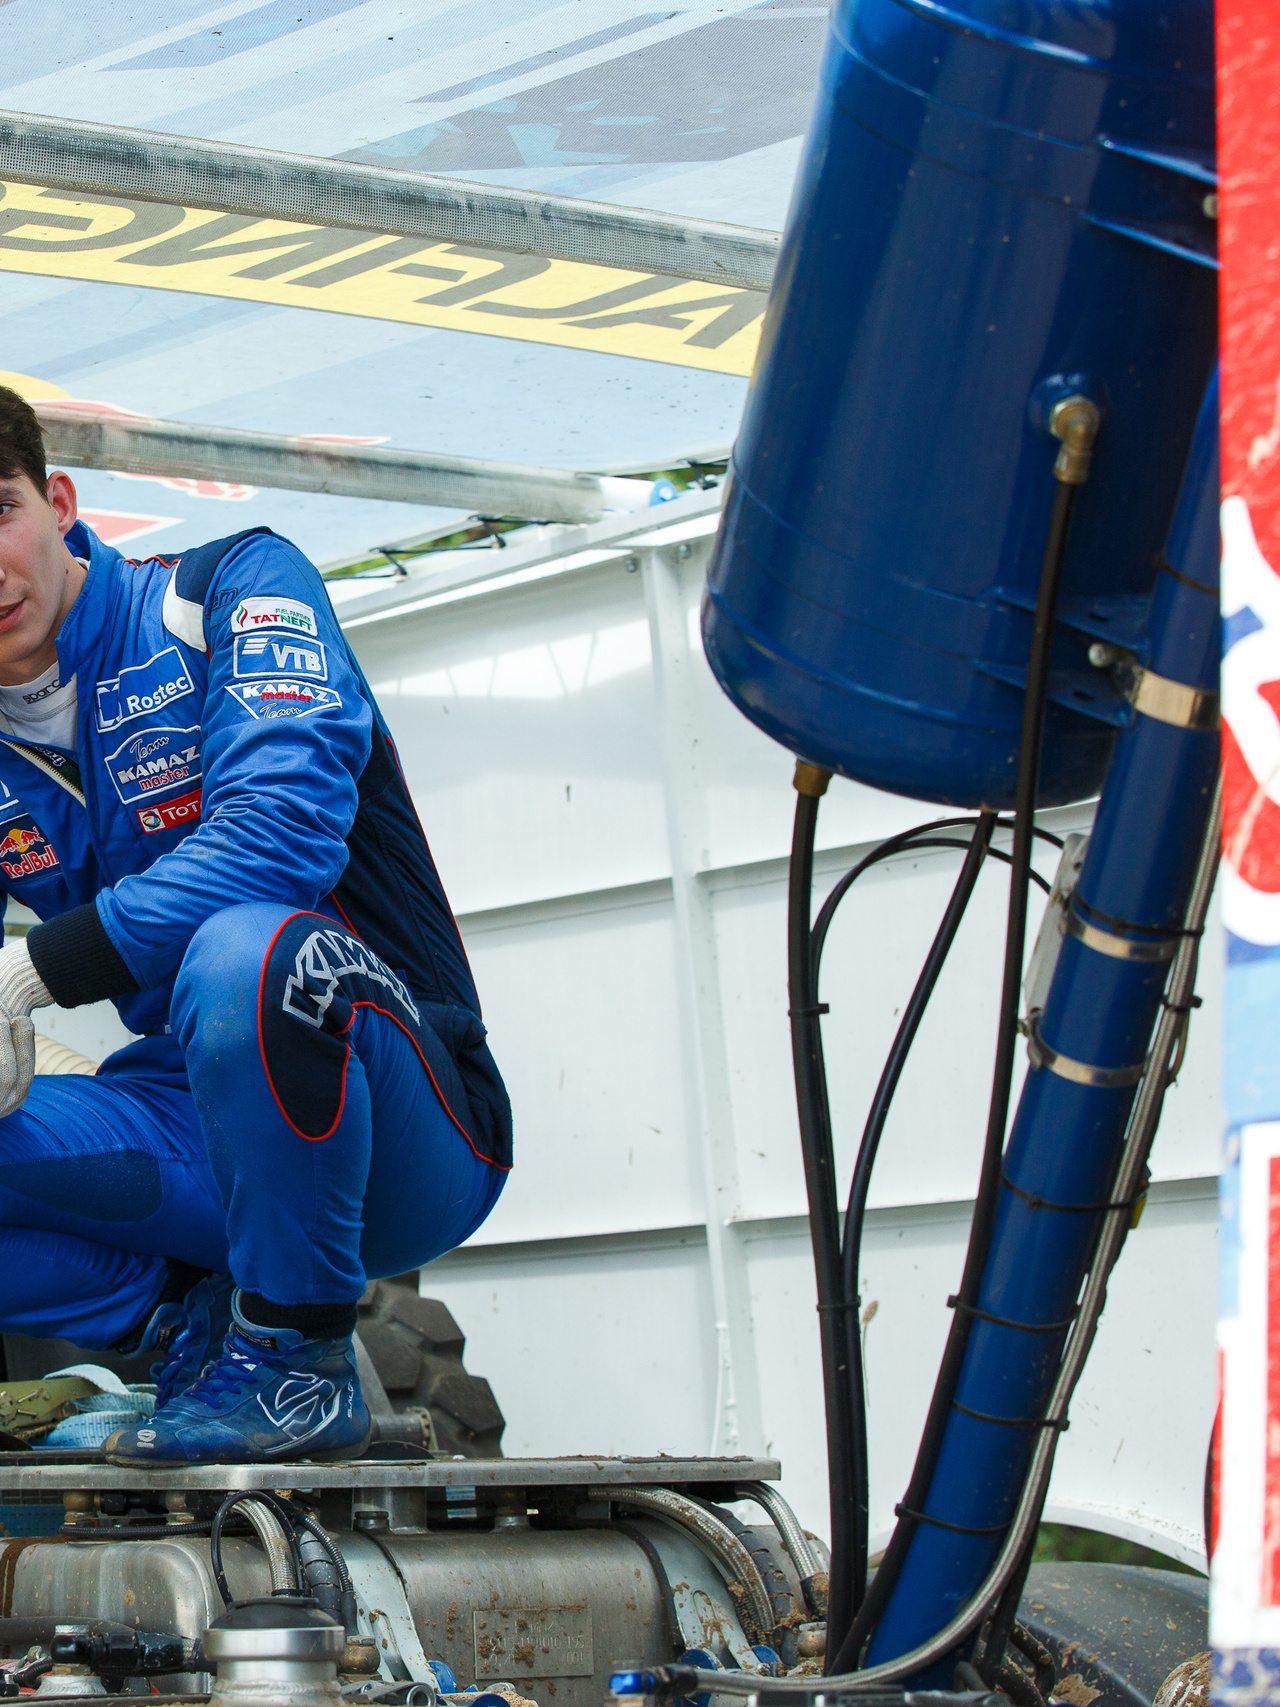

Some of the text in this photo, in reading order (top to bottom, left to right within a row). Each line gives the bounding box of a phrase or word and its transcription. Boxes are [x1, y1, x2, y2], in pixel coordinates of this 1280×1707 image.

[250, 614, 312, 631] TATNEFT
[271, 643, 322, 672] VTB
[22, 679, 60, 704] sparc
[126, 676, 189, 714] Rostec
[242, 683, 330, 702] KAMAZ
[261, 691, 312, 703] master
[260, 703, 302, 718] Team
[130, 737, 169, 762] Team
[117, 745, 200, 785] KAMAZ
[139, 766, 189, 791] master
[161, 800, 199, 820] TOT
[0, 844, 60, 879] Red Bull
